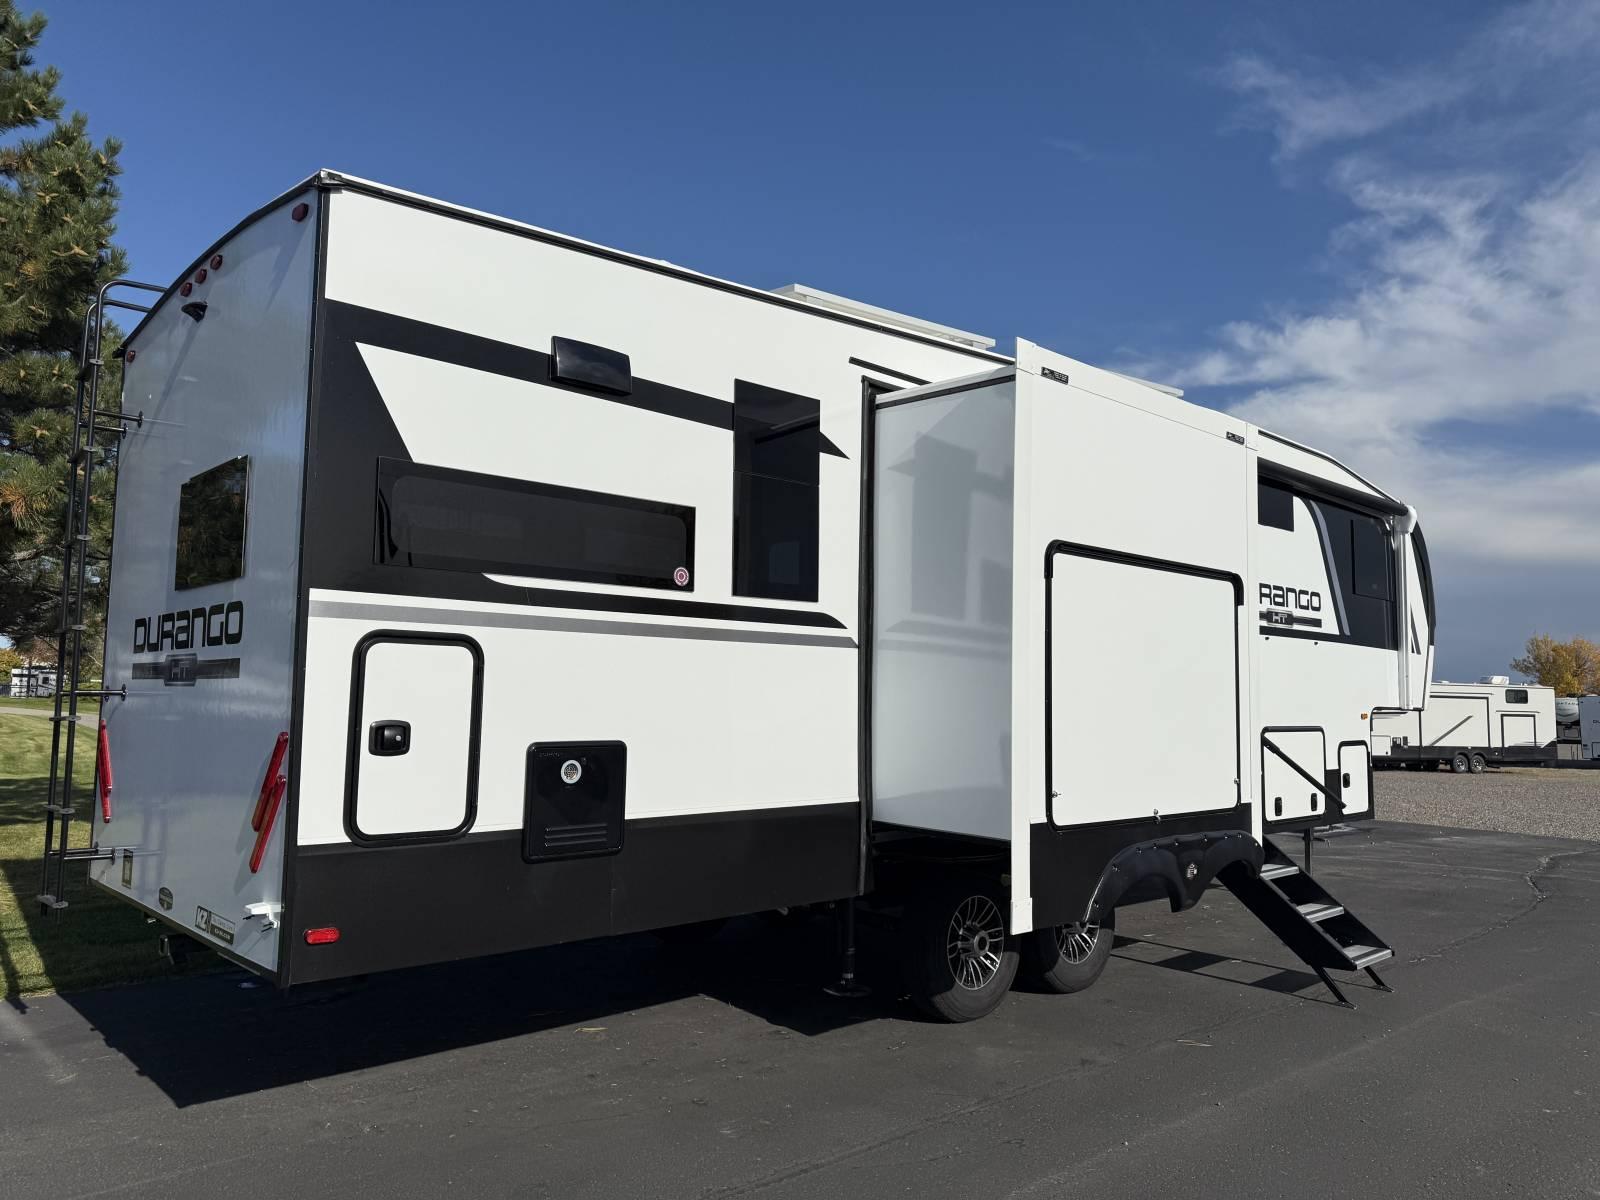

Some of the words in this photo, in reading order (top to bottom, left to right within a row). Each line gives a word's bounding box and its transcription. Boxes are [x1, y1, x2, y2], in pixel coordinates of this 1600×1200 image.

[1259, 583, 1321, 612] RANGO
[133, 600, 244, 654] DURANGO
[1272, 612, 1287, 623] HT
